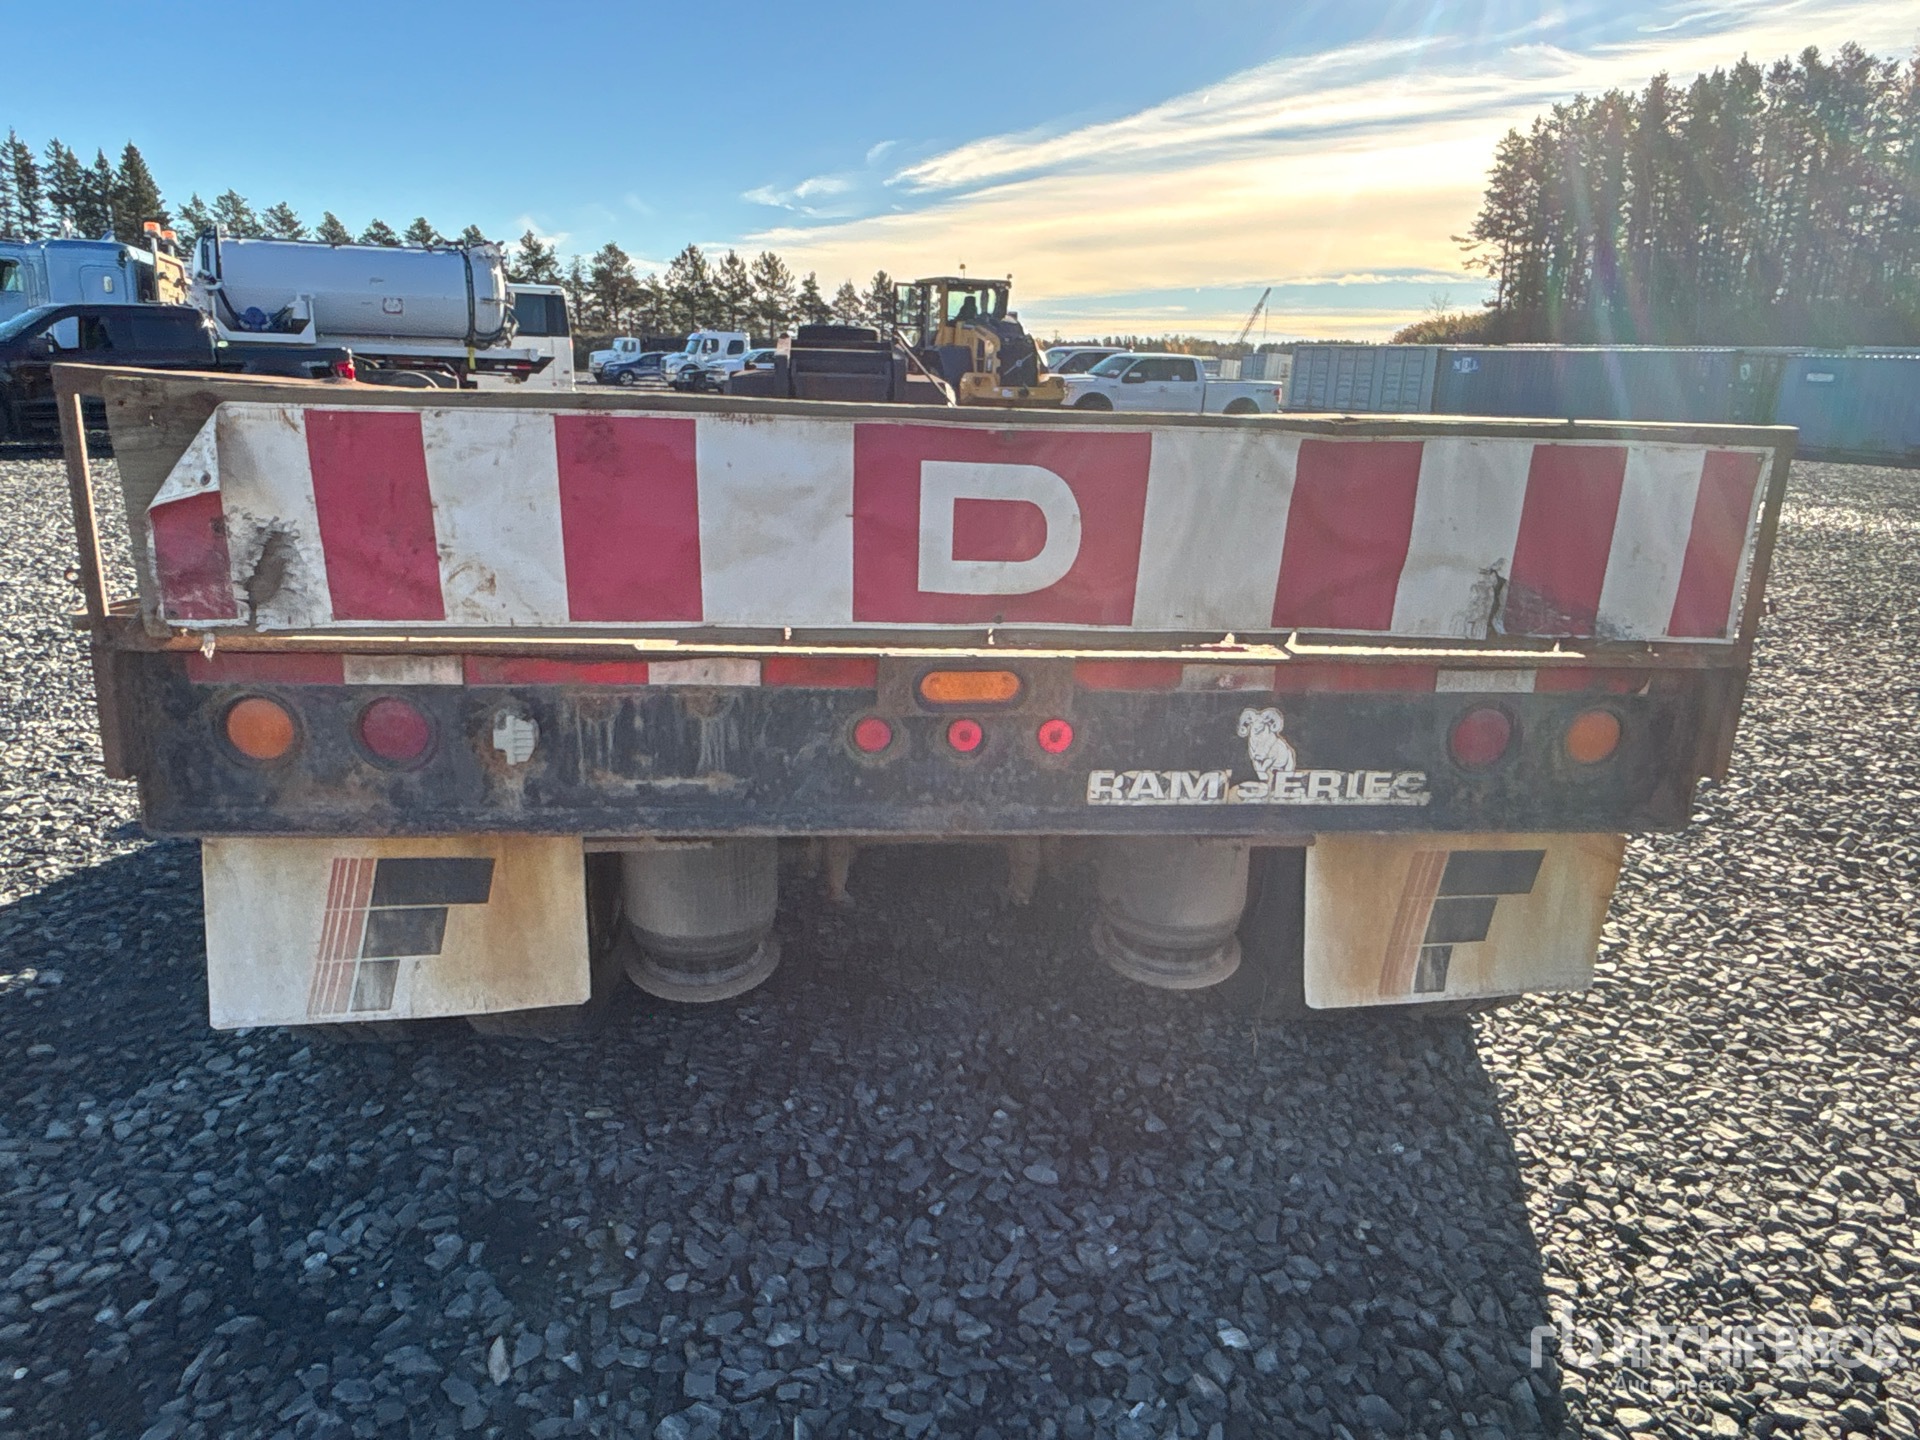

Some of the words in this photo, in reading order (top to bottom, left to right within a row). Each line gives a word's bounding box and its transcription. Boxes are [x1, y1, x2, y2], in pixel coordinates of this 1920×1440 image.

[918, 460, 1082, 595] D
[1088, 770, 1226, 804] RAM
[1236, 770, 1430, 804] SERIES
